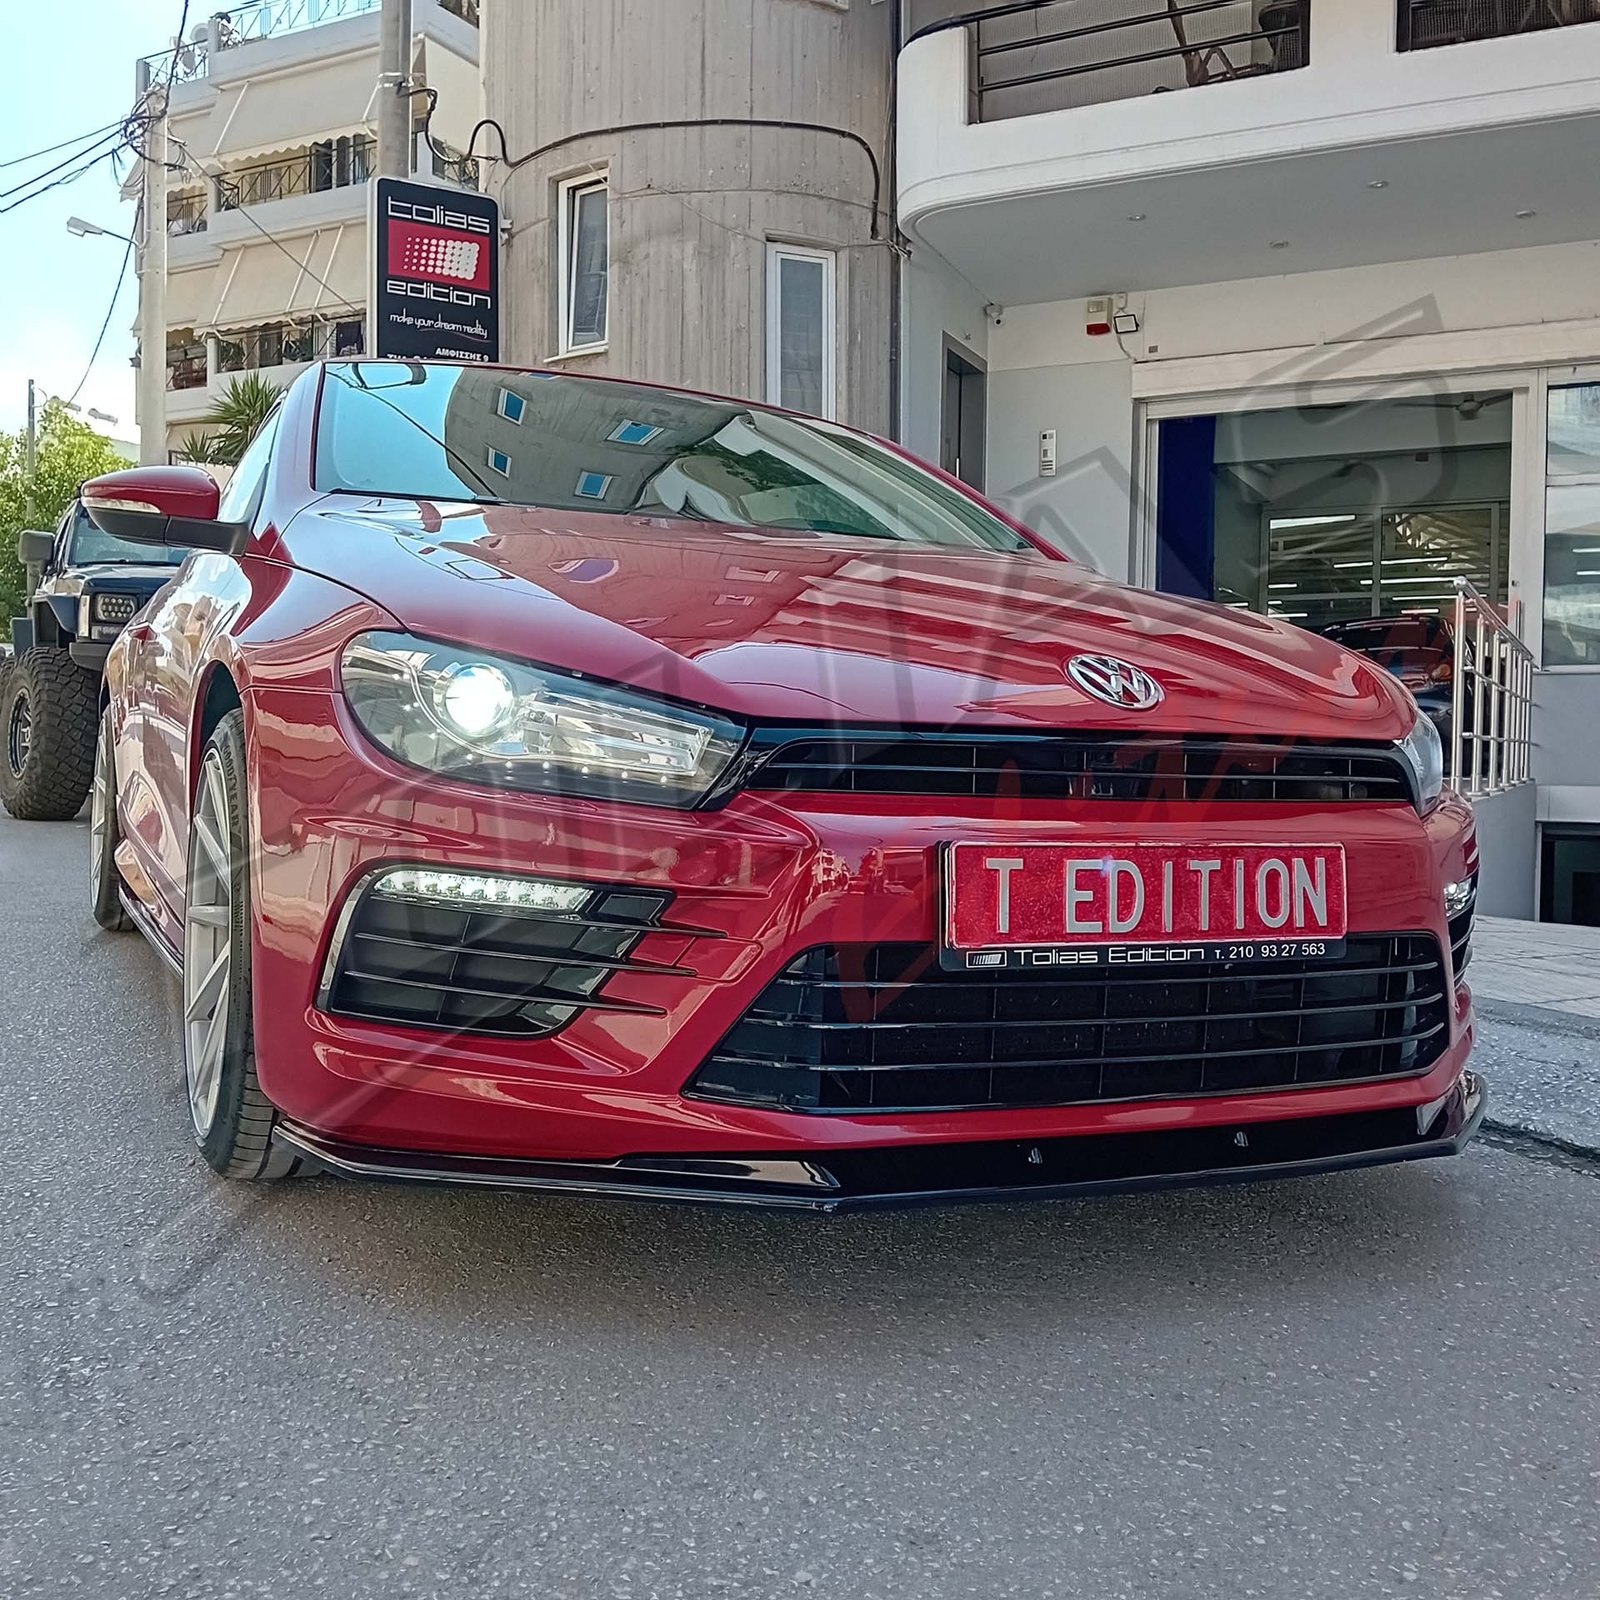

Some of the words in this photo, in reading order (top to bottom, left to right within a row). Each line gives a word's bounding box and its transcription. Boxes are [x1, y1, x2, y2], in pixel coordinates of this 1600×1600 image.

[387, 196, 490, 234] tolias
[387, 280, 491, 309] edition
[389, 307, 414, 325] make
[414, 317, 434, 329] your
[433, 313, 462, 332] dream
[462, 319, 488, 339] reality
[985, 857, 1024, 934] T
[1064, 856, 1329, 934] EDITION
[1014, 948, 1098, 965] Tolias
[1108, 946, 1205, 963] Edition
[1229, 946, 1254, 959] 210
[1261, 945, 1278, 957] 93
[1281, 944, 1297, 956] 27
[1301, 943, 1325, 956] 563
